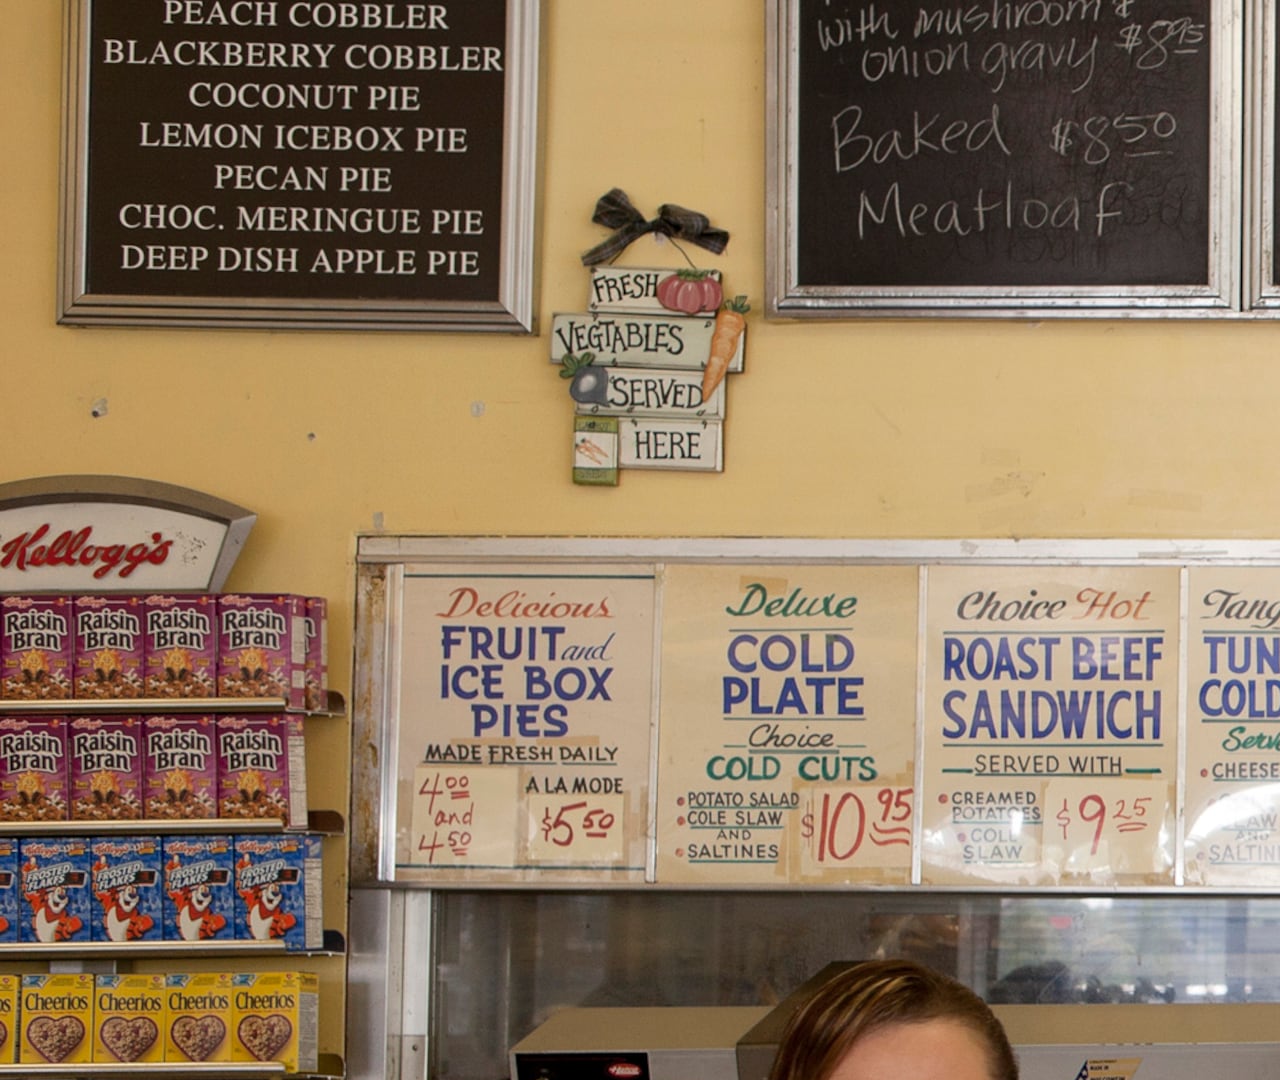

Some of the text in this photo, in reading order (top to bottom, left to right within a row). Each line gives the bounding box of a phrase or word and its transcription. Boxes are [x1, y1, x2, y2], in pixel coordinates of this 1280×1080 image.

[104, 39, 503, 71] BLACKBERRY COBBLER
[189, 82, 420, 110] COCONUT PIE
[140, 122, 467, 152] LEMON ICEBOX PIE
[832, 104, 1011, 172] Baked
[120, 204, 483, 234] CHOC. MERINGUE PIE
[859, 181, 1133, 238] Meatloaf
[121, 245, 479, 275] DEEP DISH APPLE PIE
[593, 274, 658, 304] FRESH
[555, 320, 683, 356] VEGTABLES
[609, 378, 708, 408] SERVED
[635, 431, 701, 459] HERE
[1, 523, 173, 579] Kellogg's
[436, 587, 611, 618] Delicious
[726, 583, 857, 618] Deluxe
[957, 588, 1151, 621] Choice Hot
[148, 609, 210, 649] Raisin Bran
[224, 609, 285, 649] Raisin Bran
[442, 626, 615, 661] FRUIT and
[728, 634, 854, 673] COLD
[944, 637, 1163, 681] ROAST BEEF
[441, 665, 613, 701] ICE BOX
[723, 677, 864, 715] PLATE
[471, 704, 568, 737] PIES
[943, 690, 1161, 739] SANDWICH
[423, 744, 617, 765] MADE FRESH DAILY
[707, 756, 877, 781] COLD CUTS
[975, 755, 1122, 777] SERVED WITH
[1212, 762, 1280, 781] CHEESE
[241, 862, 282, 881] FROSTED
[25, 992, 88, 1012] Cheerios
[235, 991, 295, 1010] Cheerios
